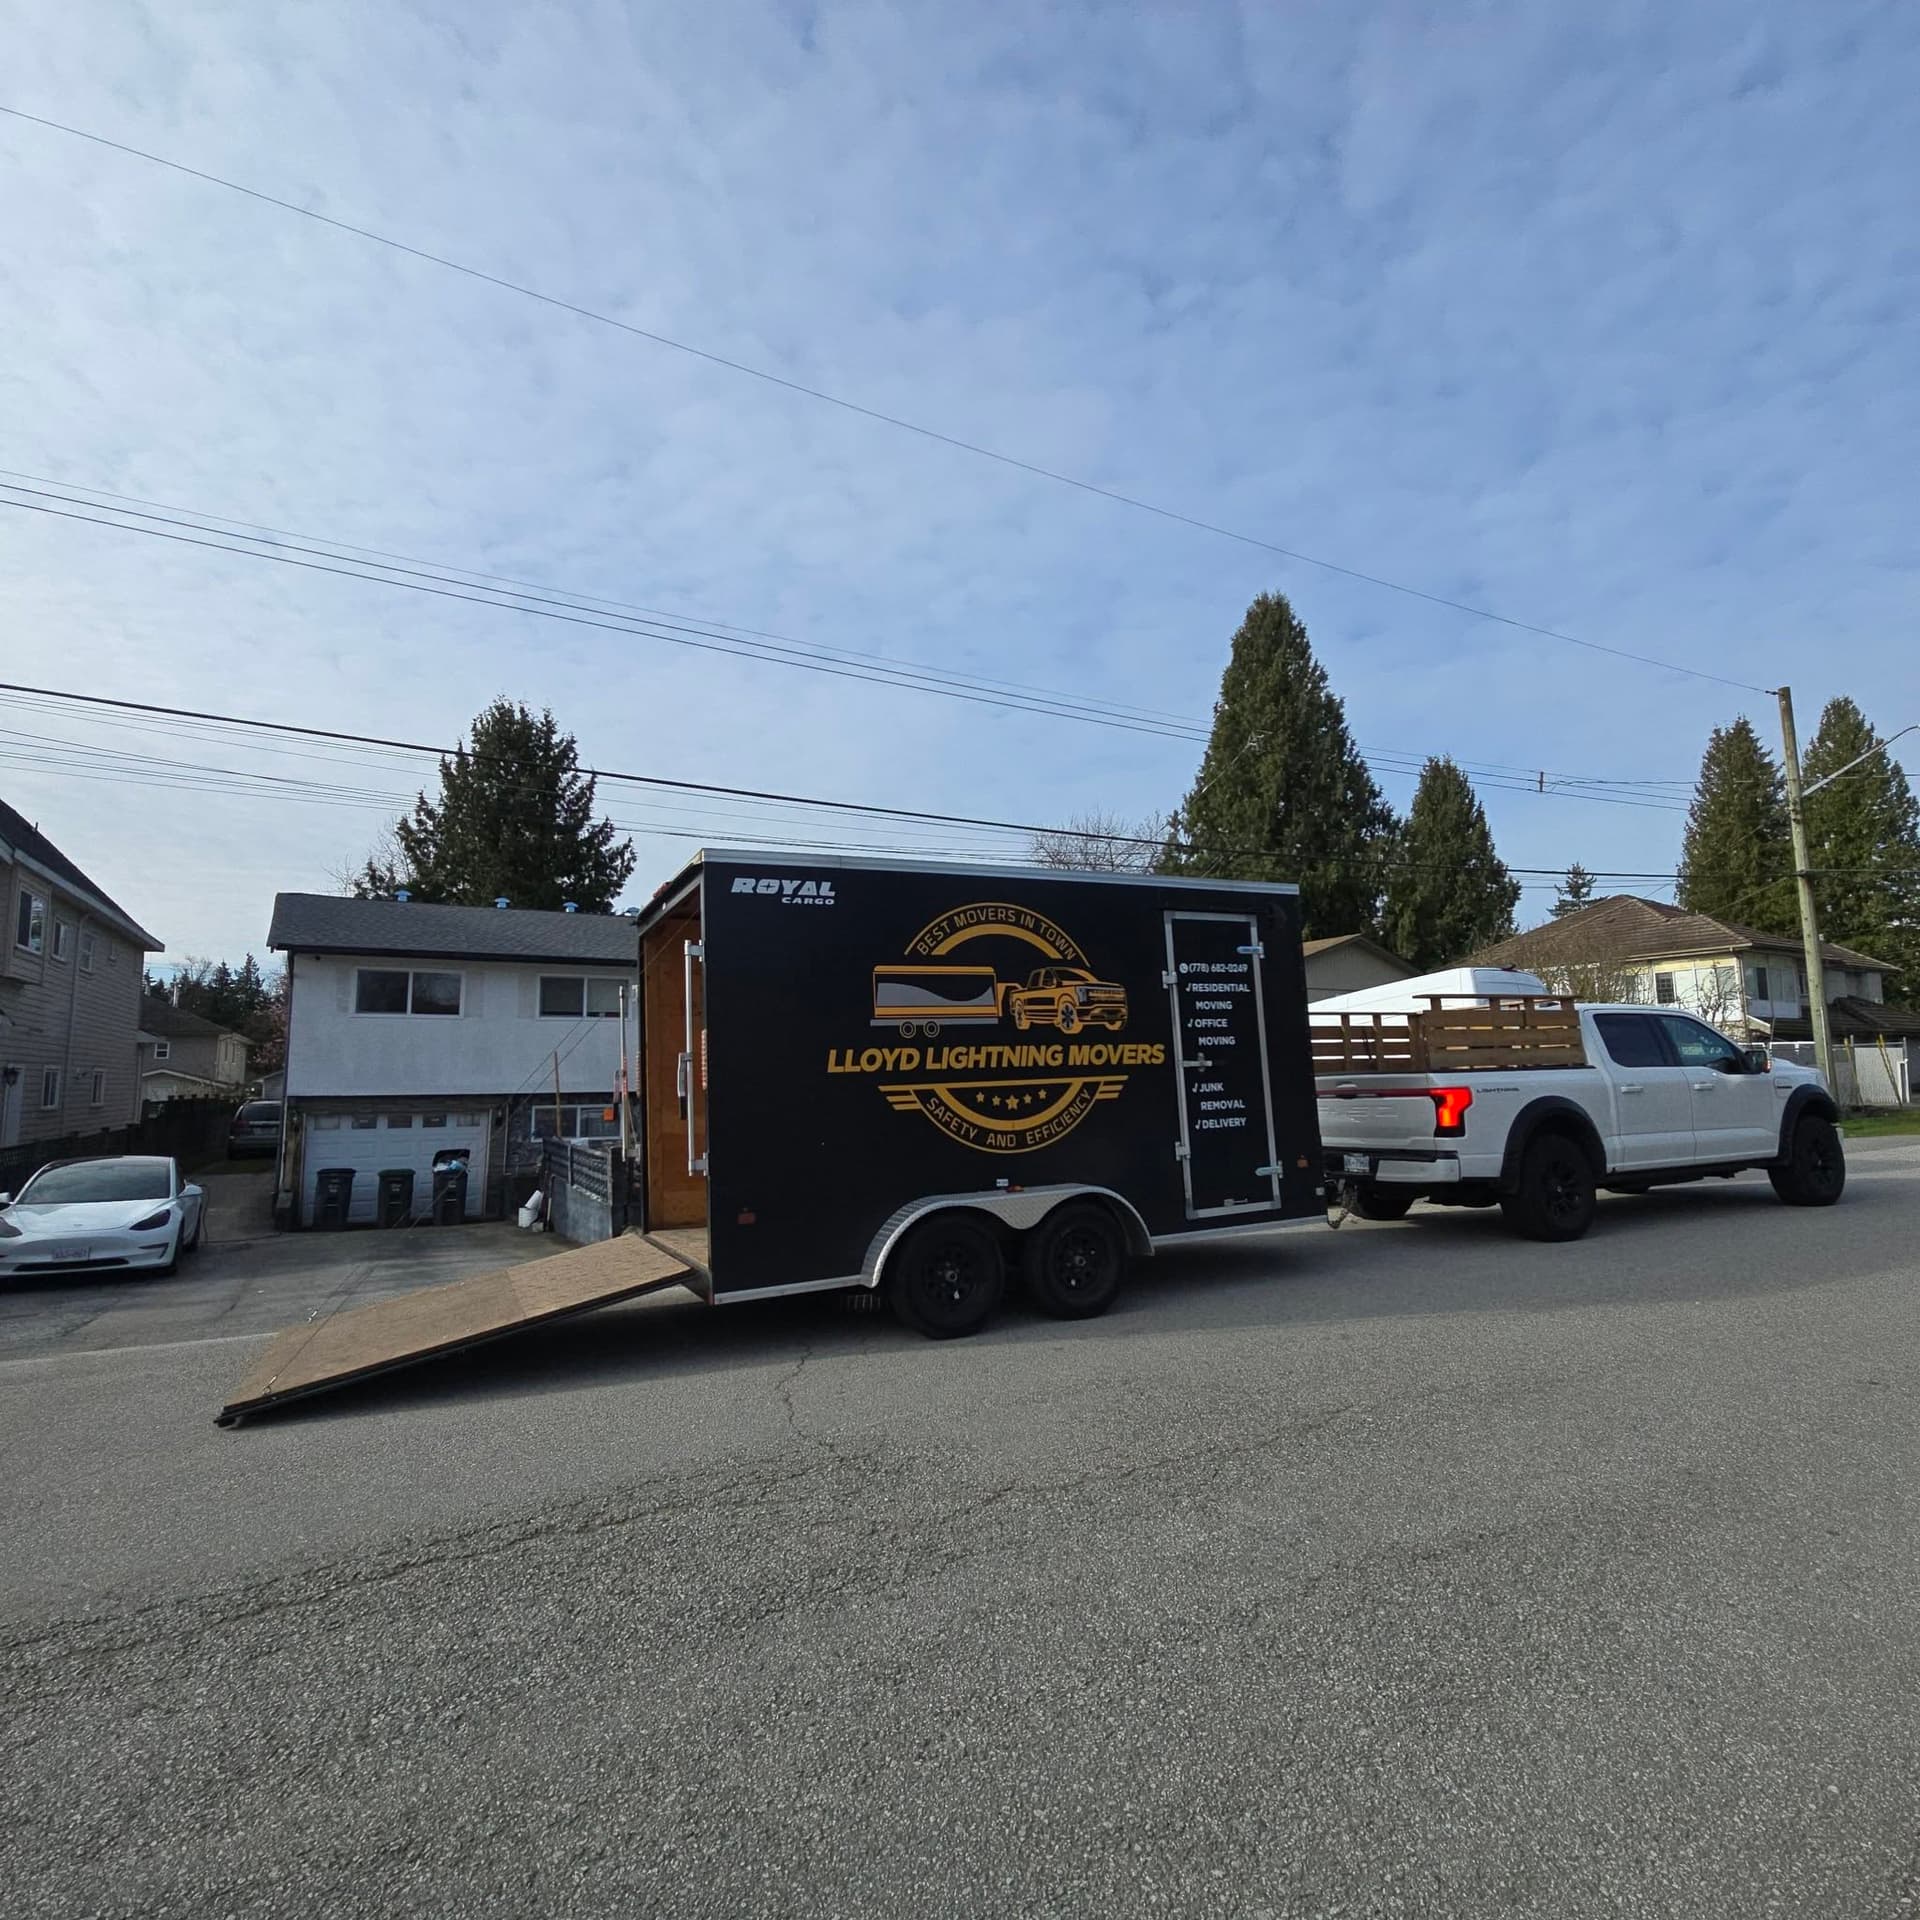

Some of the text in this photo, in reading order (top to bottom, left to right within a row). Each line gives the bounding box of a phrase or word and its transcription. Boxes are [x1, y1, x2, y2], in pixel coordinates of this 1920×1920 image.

[731, 877, 836, 897] ROYAL
[781, 896, 835, 905] CARGO
[917, 908, 1077, 961] BEST MOVERS IN TOWN
[1191, 983, 1251, 993] RESIDENTIAL
[1195, 1001, 1233, 1010] MOVING
[1194, 1018, 1229, 1028] OFFICE
[1198, 1036, 1237, 1046] MOVING
[827, 1044, 1166, 1074] LLOYD LIGHTNING MOVERS
[1199, 1082, 1225, 1093] JUNK
[1200, 1099, 1246, 1111] REMOVAL
[926, 1088, 1091, 1148] SAFETY AND EFFICIENCY
[1202, 1117, 1247, 1129] DELIVERY
